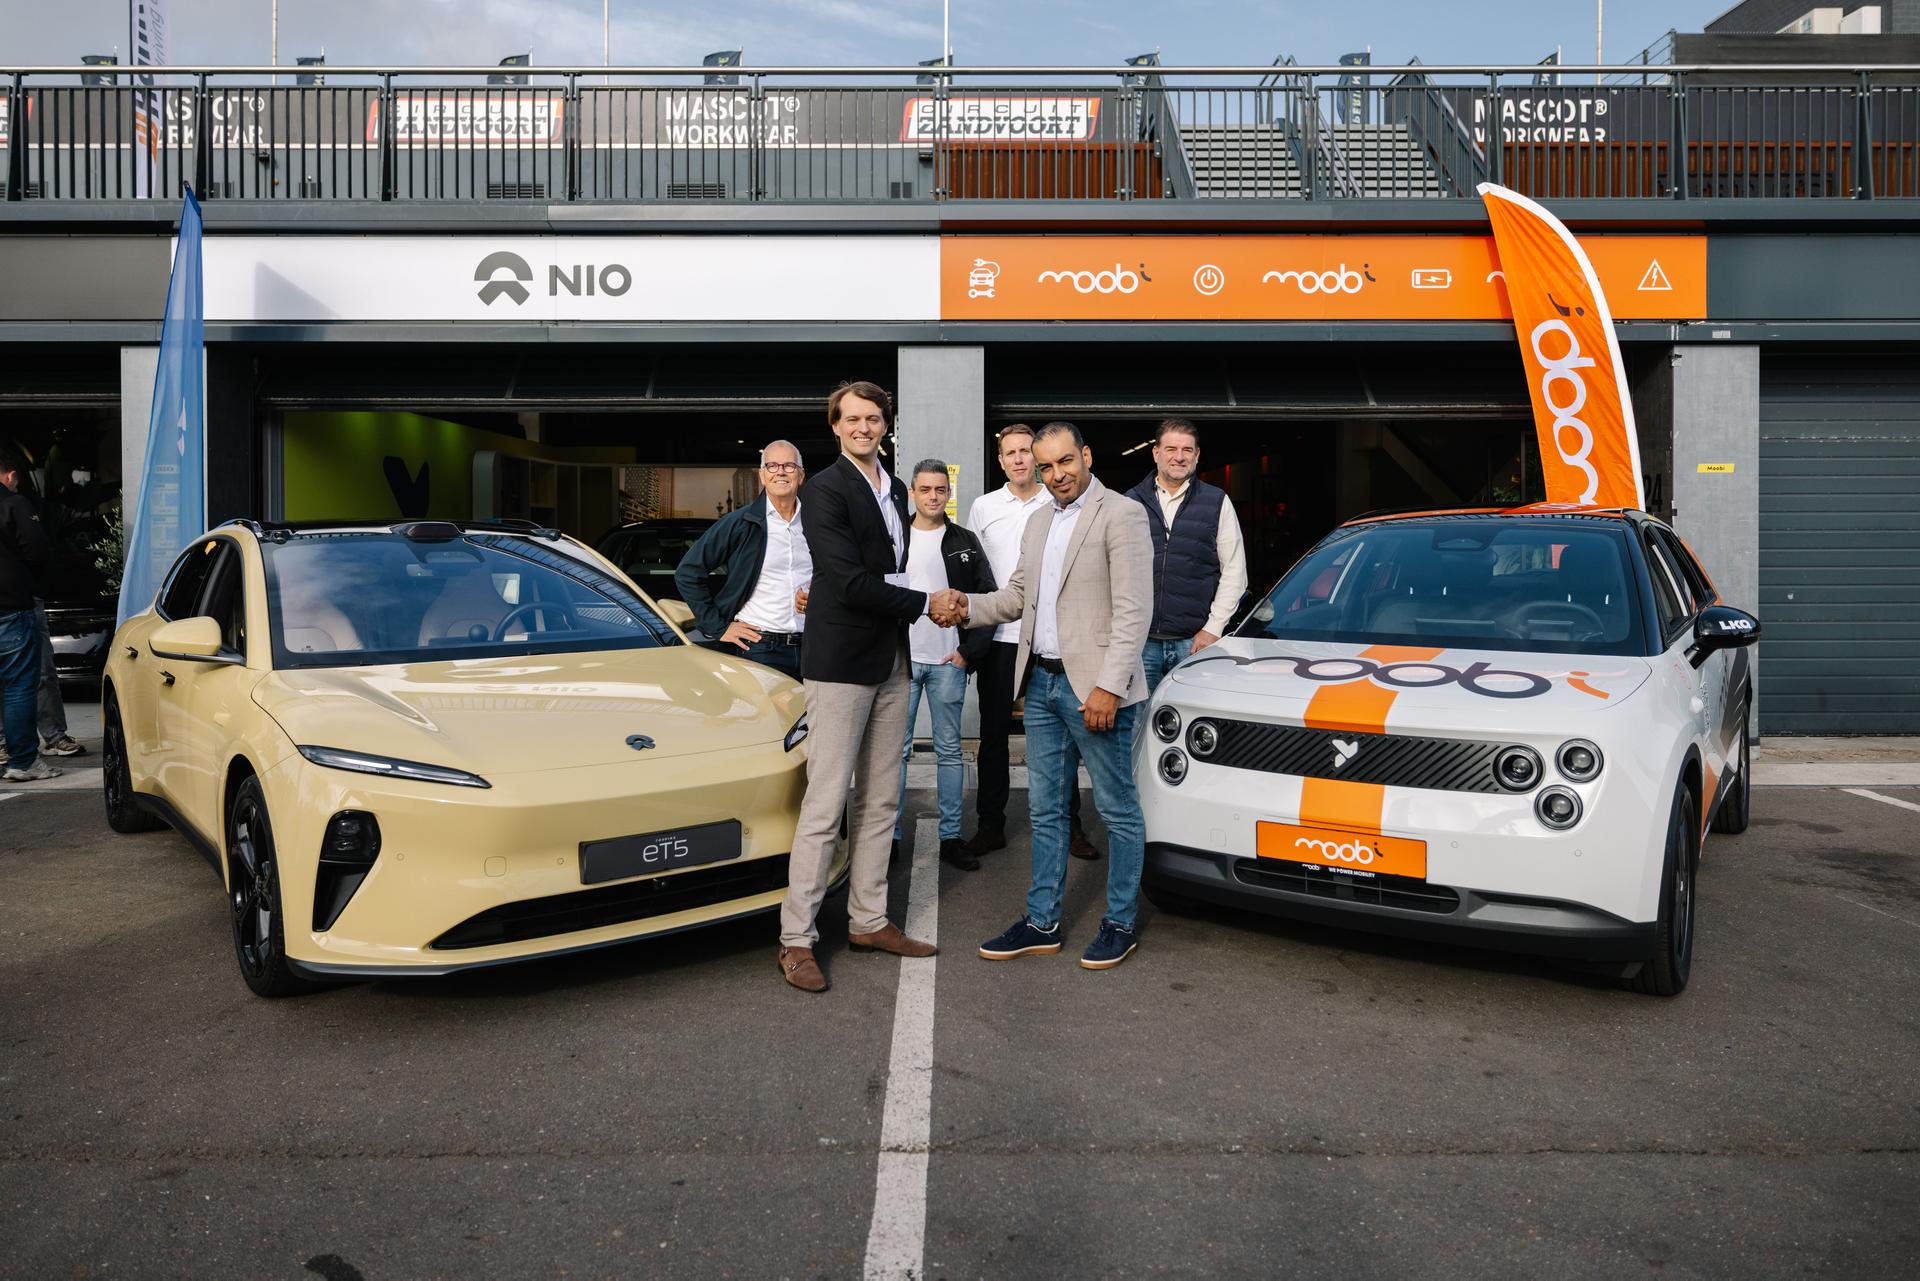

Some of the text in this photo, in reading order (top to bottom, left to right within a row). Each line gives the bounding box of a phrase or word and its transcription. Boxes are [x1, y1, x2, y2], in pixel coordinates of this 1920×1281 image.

[149, 8, 166, 66] riving
[396, 104, 549, 114] IRCUIT
[921, 104, 1082, 114] CIRCUIT
[396, 116, 548, 135] ANDVOORT
[665, 125, 799, 143] WORKWEAR
[917, 116, 1081, 135] ZANDVOORT
[549, 264, 632, 297] NIO
[1038, 263, 1152, 294] moobi
[1262, 263, 1376, 294] moobi
[1718, 619, 1753, 631] LKQ
[1180, 655, 1610, 700] moobi
[643, 839, 689, 862] eT5
[1295, 837, 1384, 865] moobi
[1353, 869, 1376, 878] MOBILITY
